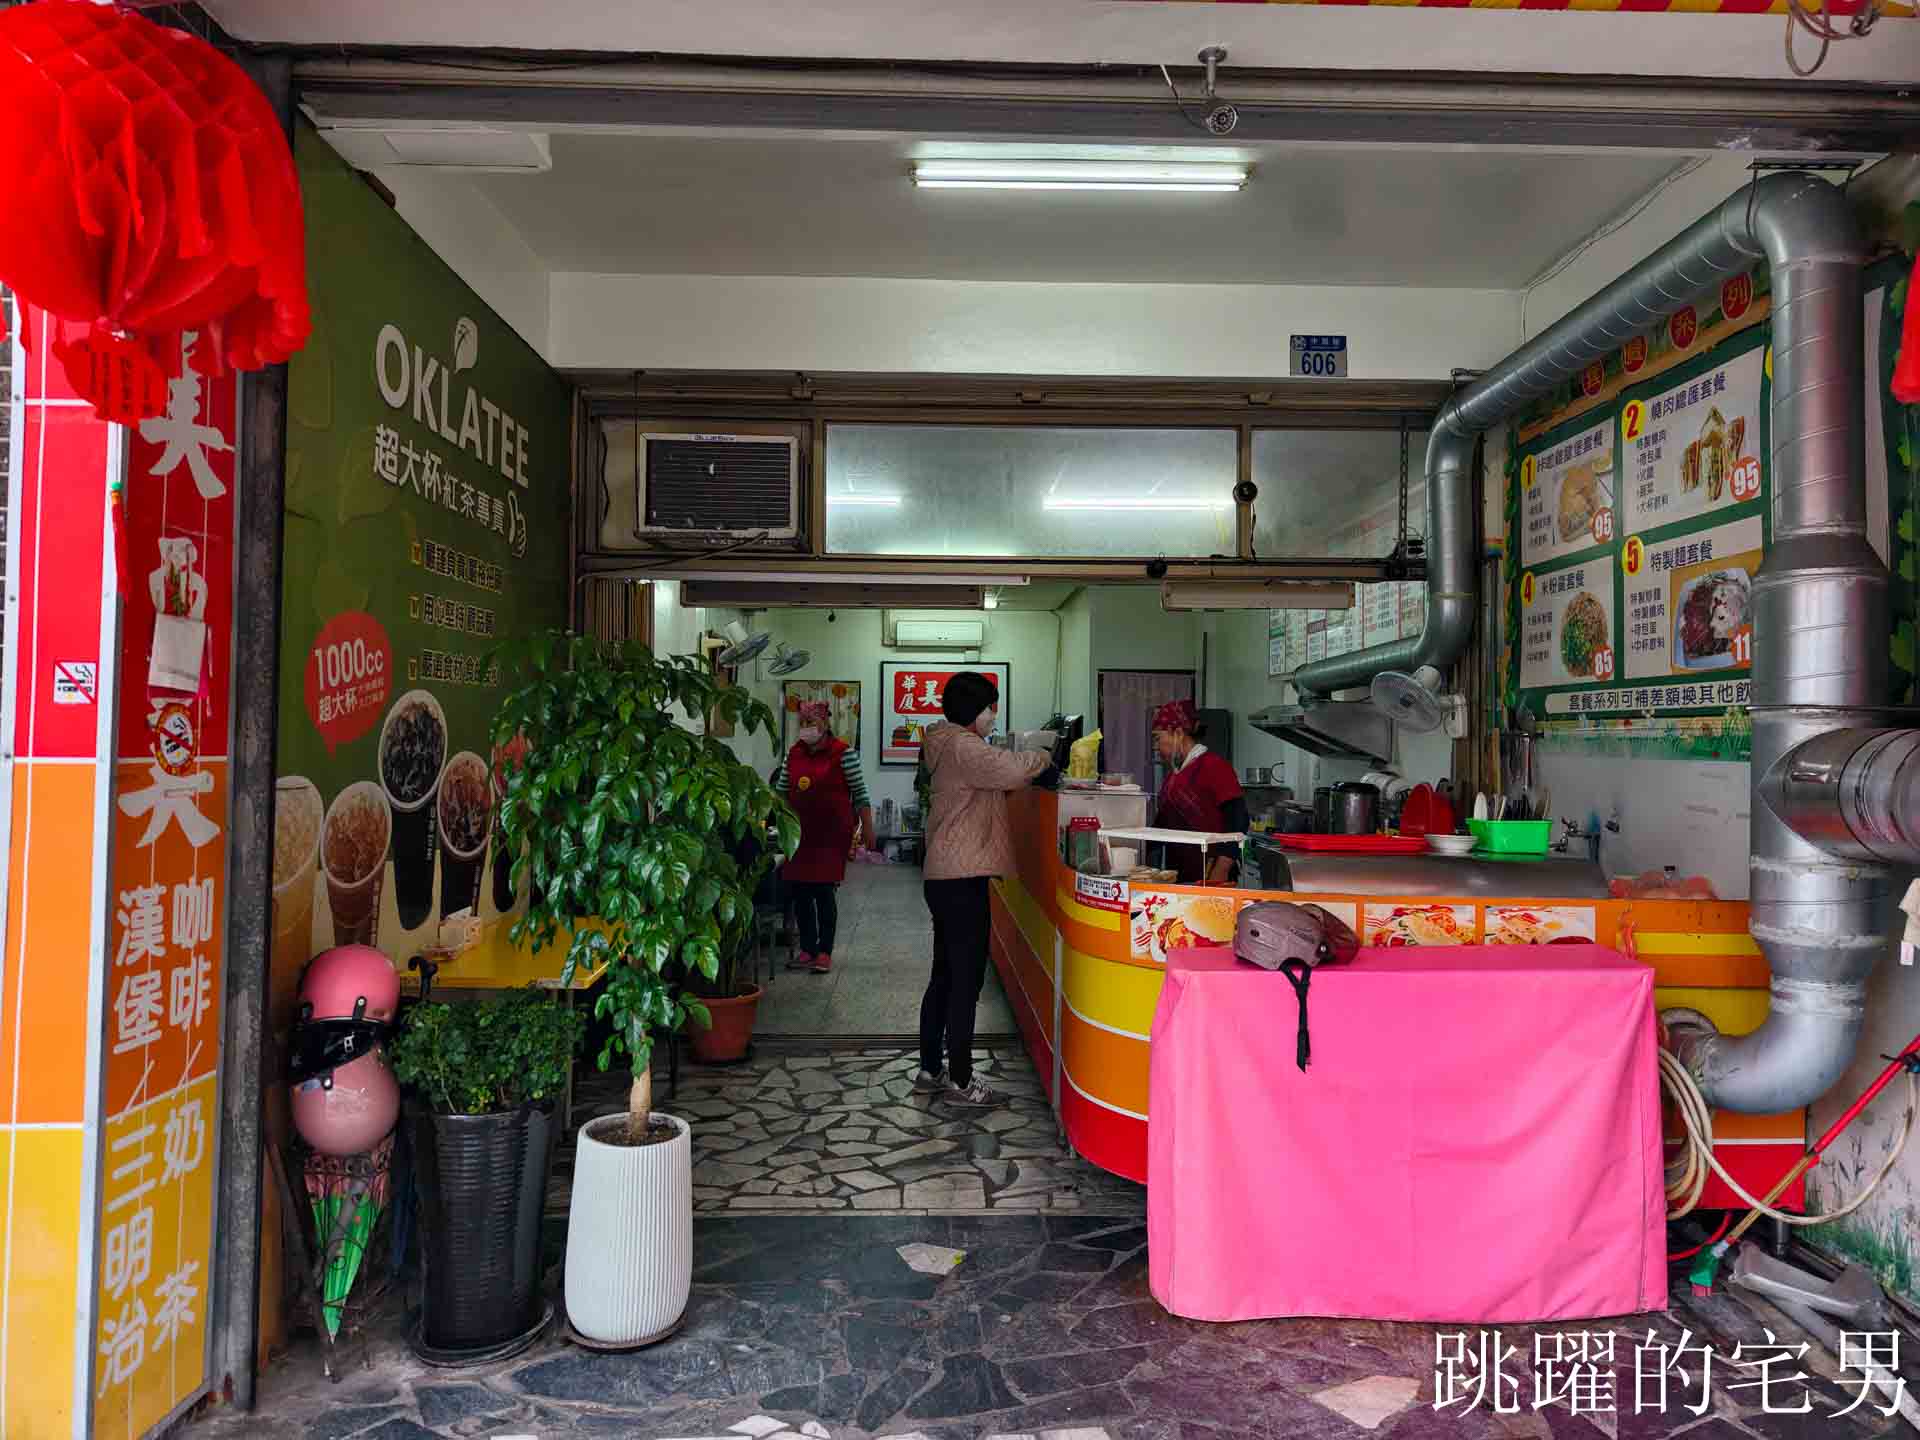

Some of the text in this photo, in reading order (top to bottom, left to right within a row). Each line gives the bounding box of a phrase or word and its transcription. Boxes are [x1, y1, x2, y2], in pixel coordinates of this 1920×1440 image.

[1302, 352, 1336, 375] 606
[376, 324, 528, 489] OKLATEE
[1627, 404, 1639, 439] 2
[373, 423, 505, 536] 超大杯紅茶專賣
[1525, 457, 1532, 488] 1
[1734, 459, 1759, 497] 95
[1627, 539, 1639, 573] 5
[1524, 575, 1532, 602] 4
[315, 638, 384, 692] 1000cc
[1594, 649, 1613, 676] 85
[318, 685, 358, 726] 超大杯
[113, 885, 167, 1056] 漢堡
[168, 876, 215, 1029] 咖啡
[151, 1098, 205, 1352] 奶茶
[97, 1122, 157, 1400] 三明治
